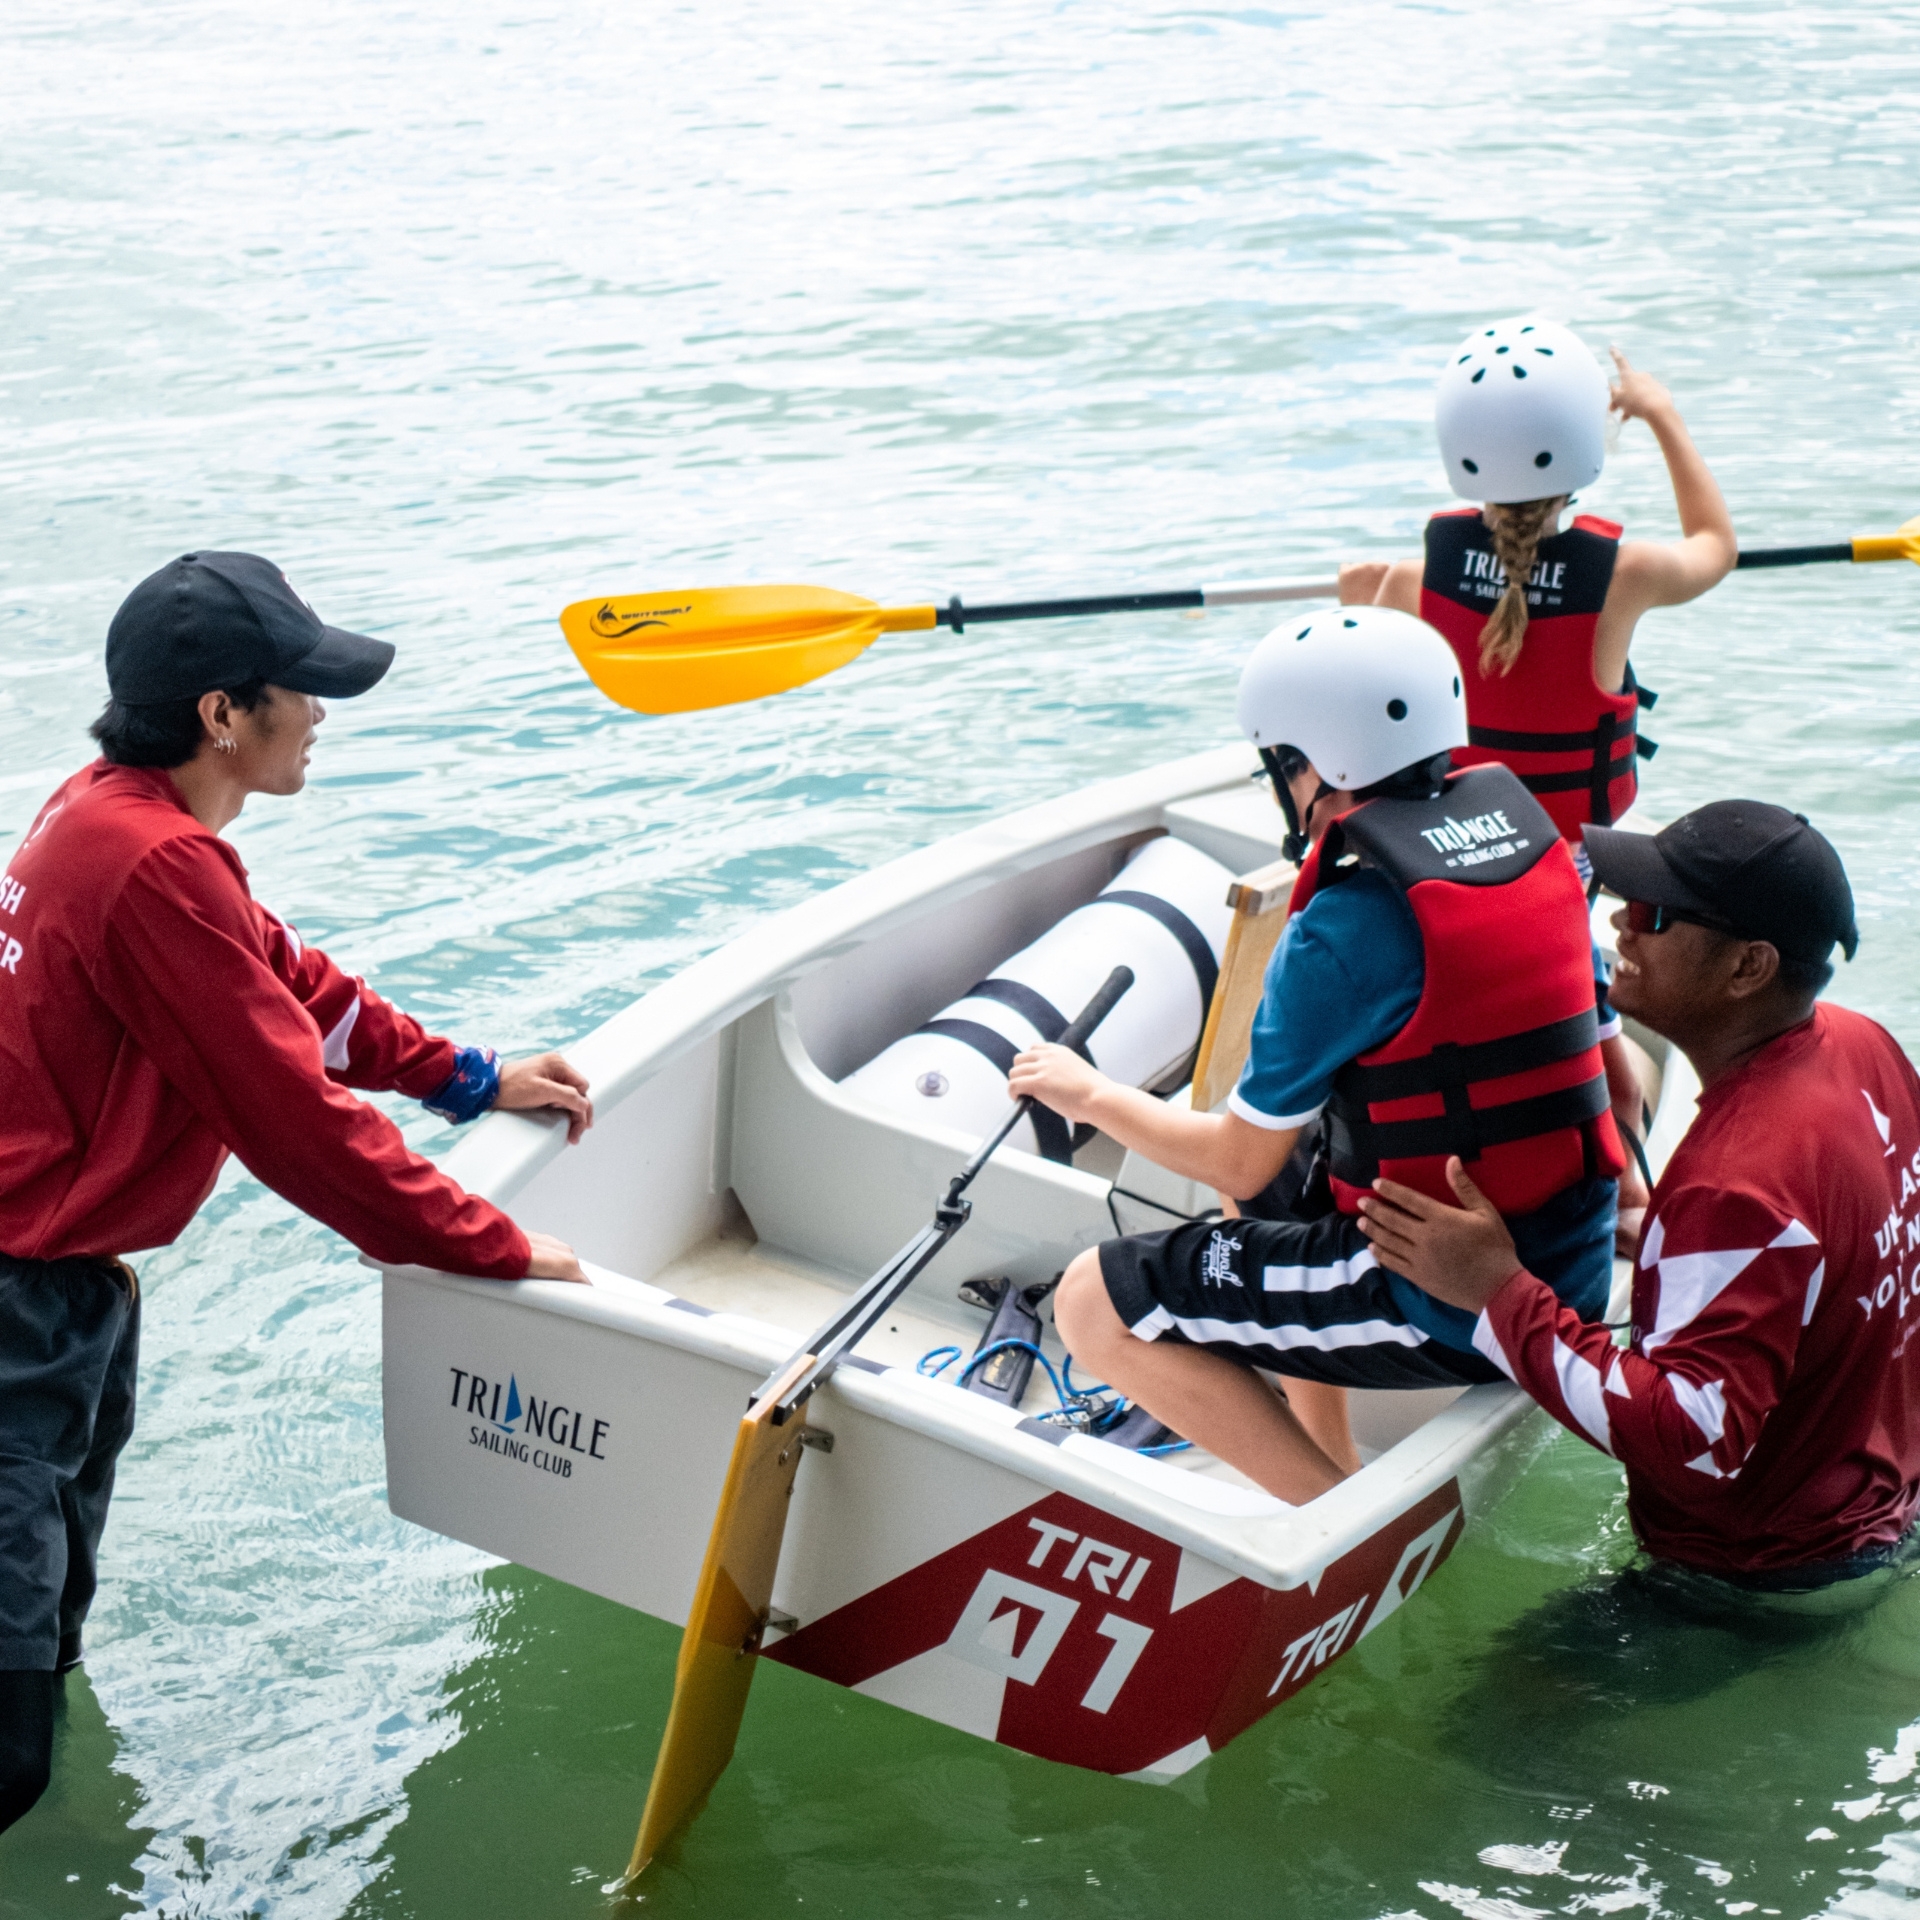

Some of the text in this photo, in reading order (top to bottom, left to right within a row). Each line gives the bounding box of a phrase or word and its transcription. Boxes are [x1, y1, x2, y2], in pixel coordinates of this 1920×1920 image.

[1420, 809, 1518, 853] TRIANGLE
[450, 1367, 611, 1461] TRIANGLE
[468, 1426, 573, 1479] SAILING CLUB
[1026, 1516, 1153, 1602] TRI
[942, 1567, 1155, 1715] 01
[1266, 1593, 1370, 1698] TRI
